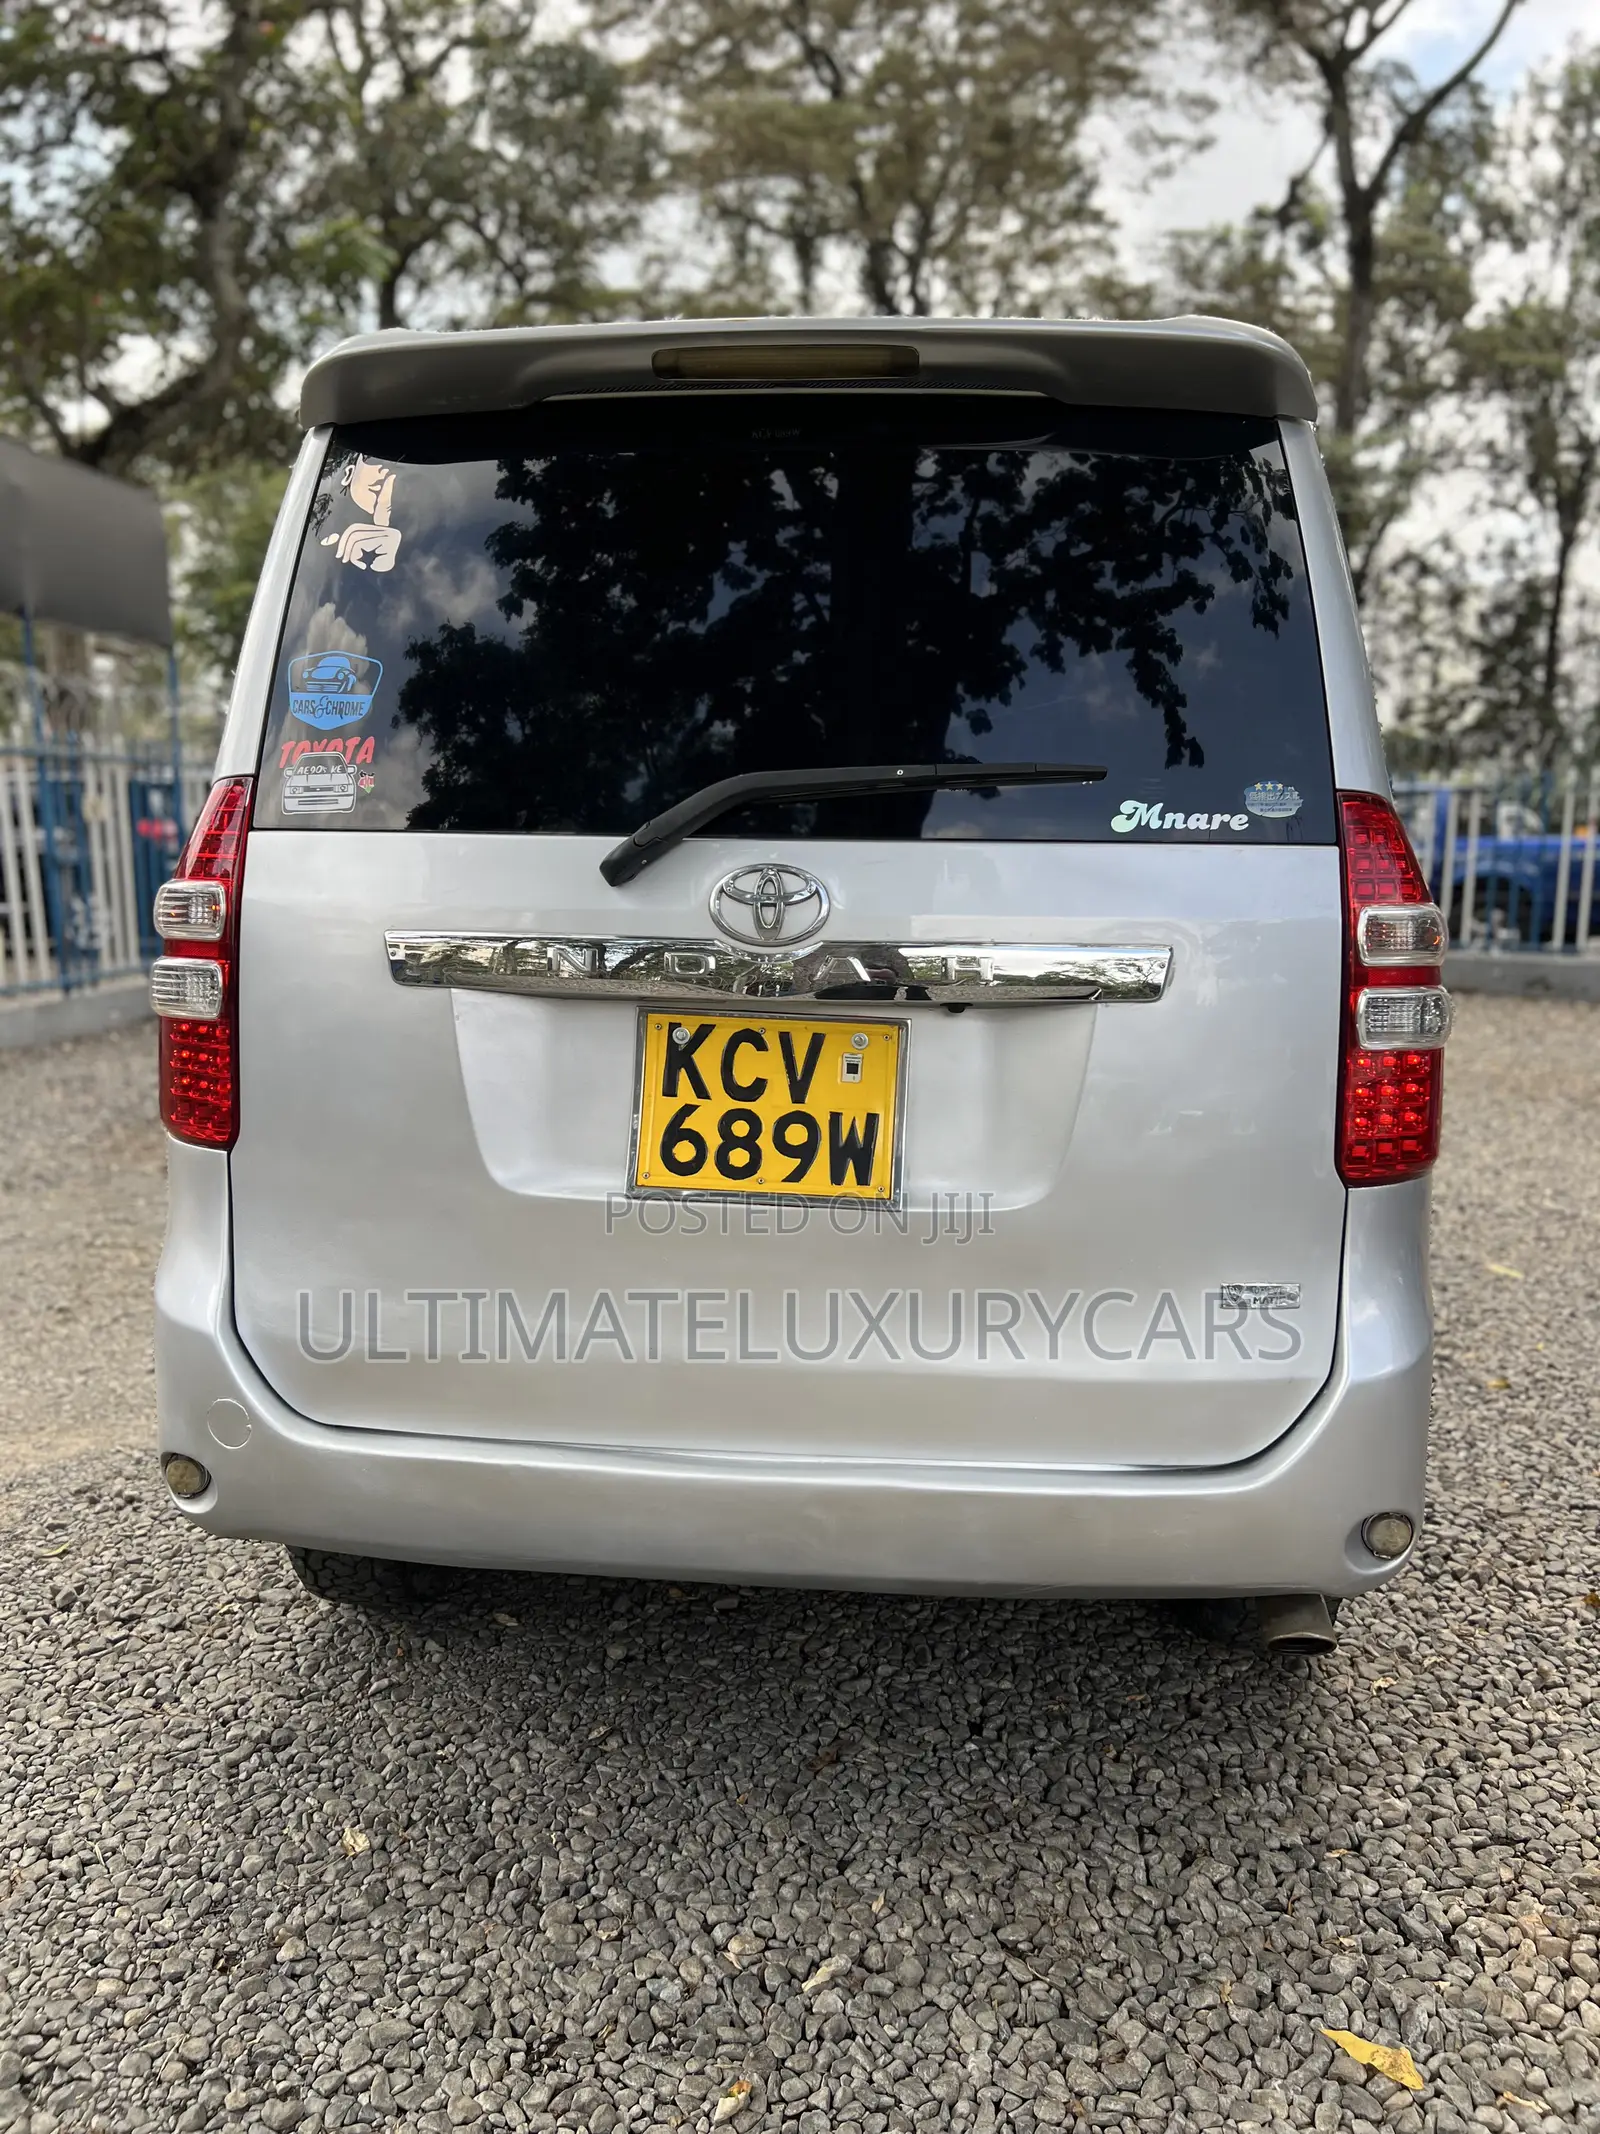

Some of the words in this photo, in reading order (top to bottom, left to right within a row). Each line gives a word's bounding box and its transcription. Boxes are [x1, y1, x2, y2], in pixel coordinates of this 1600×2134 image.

[1110, 800, 1249, 833] Mnare
[662, 1022, 826, 1104] KCV
[660, 1103, 880, 1186] 689W
